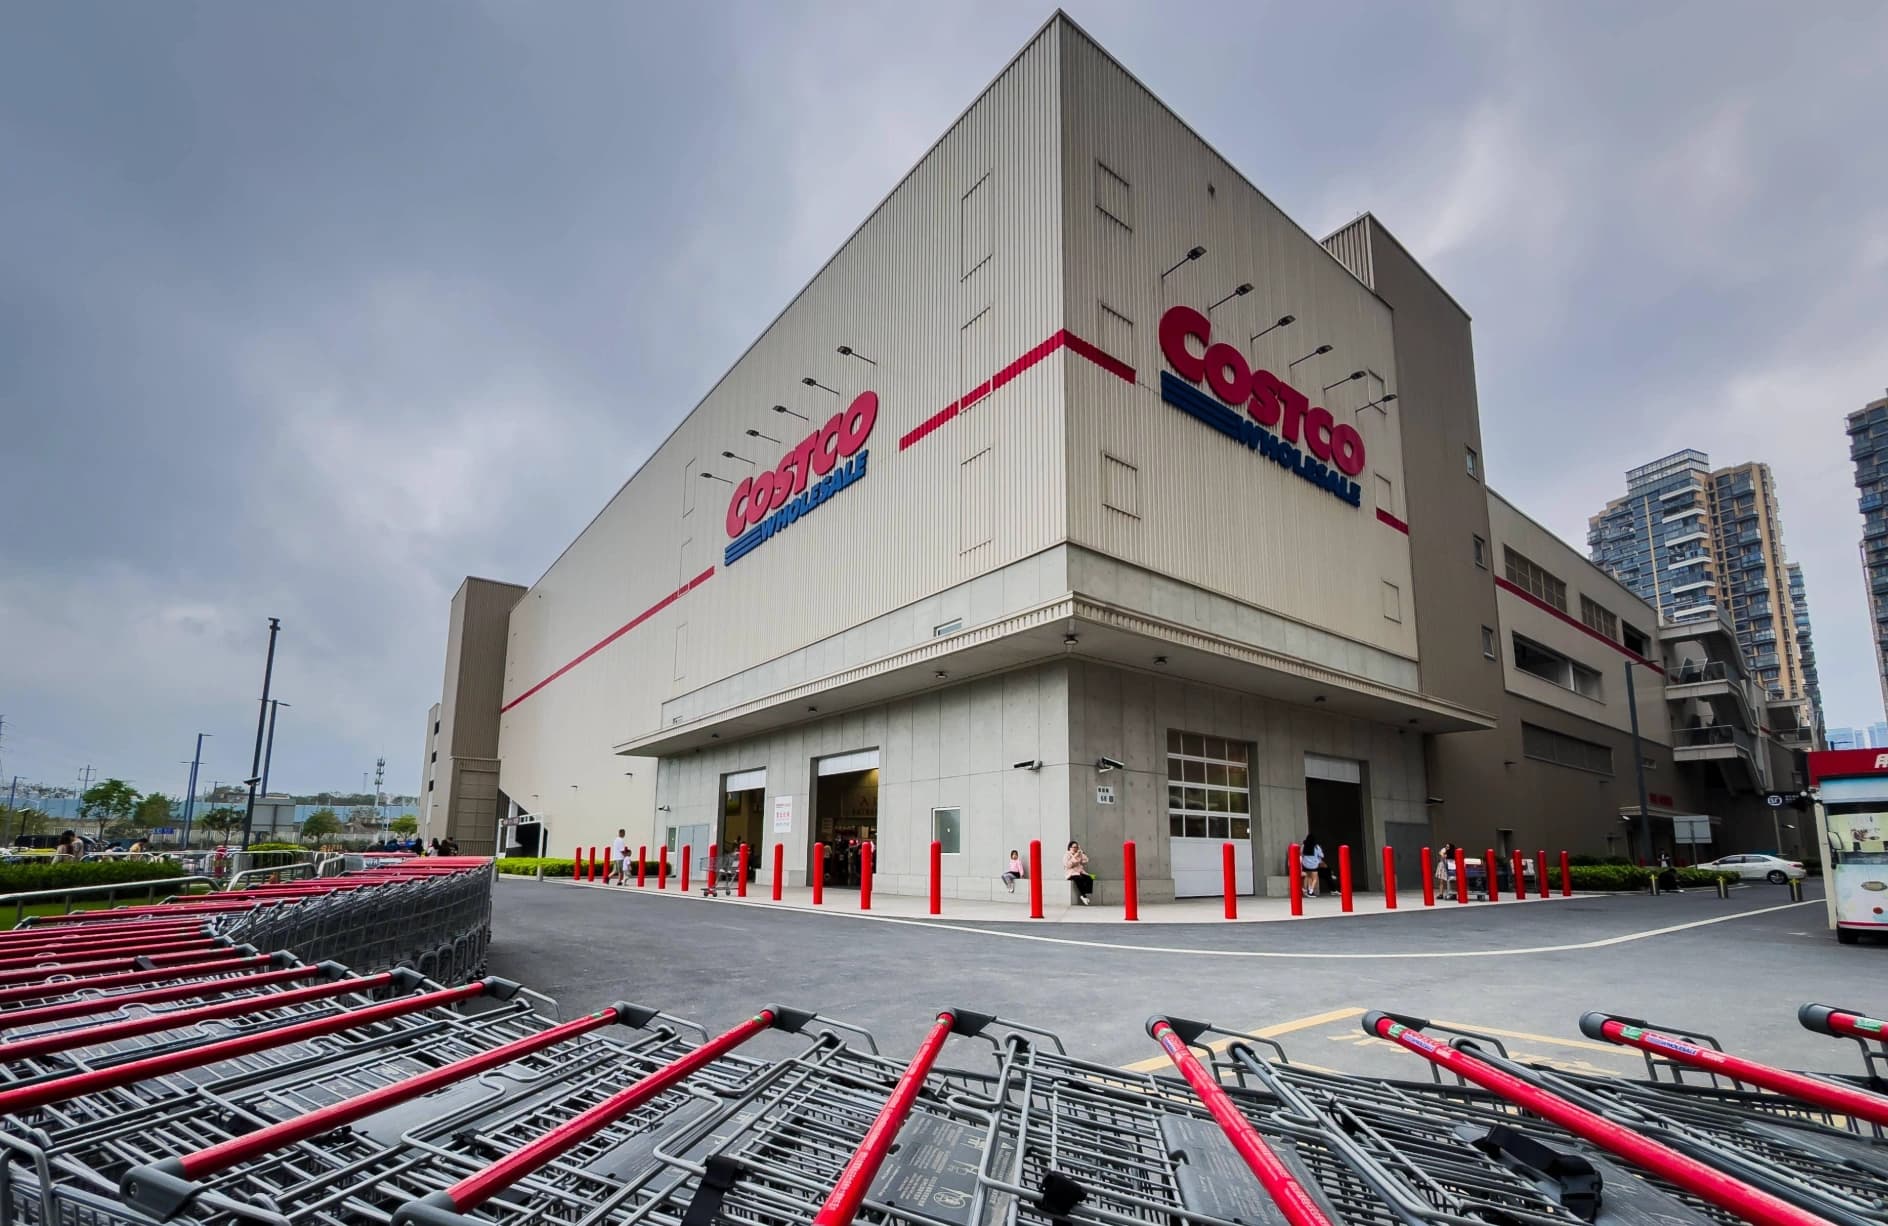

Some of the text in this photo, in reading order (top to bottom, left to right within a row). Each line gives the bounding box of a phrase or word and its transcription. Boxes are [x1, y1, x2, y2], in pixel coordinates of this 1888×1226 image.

[1159, 305, 1365, 476] COSTCO
[726, 391, 879, 538] COSTCO
[760, 449, 869, 542] WHOLESALE
[1239, 417, 1361, 508] WHOLESALE
